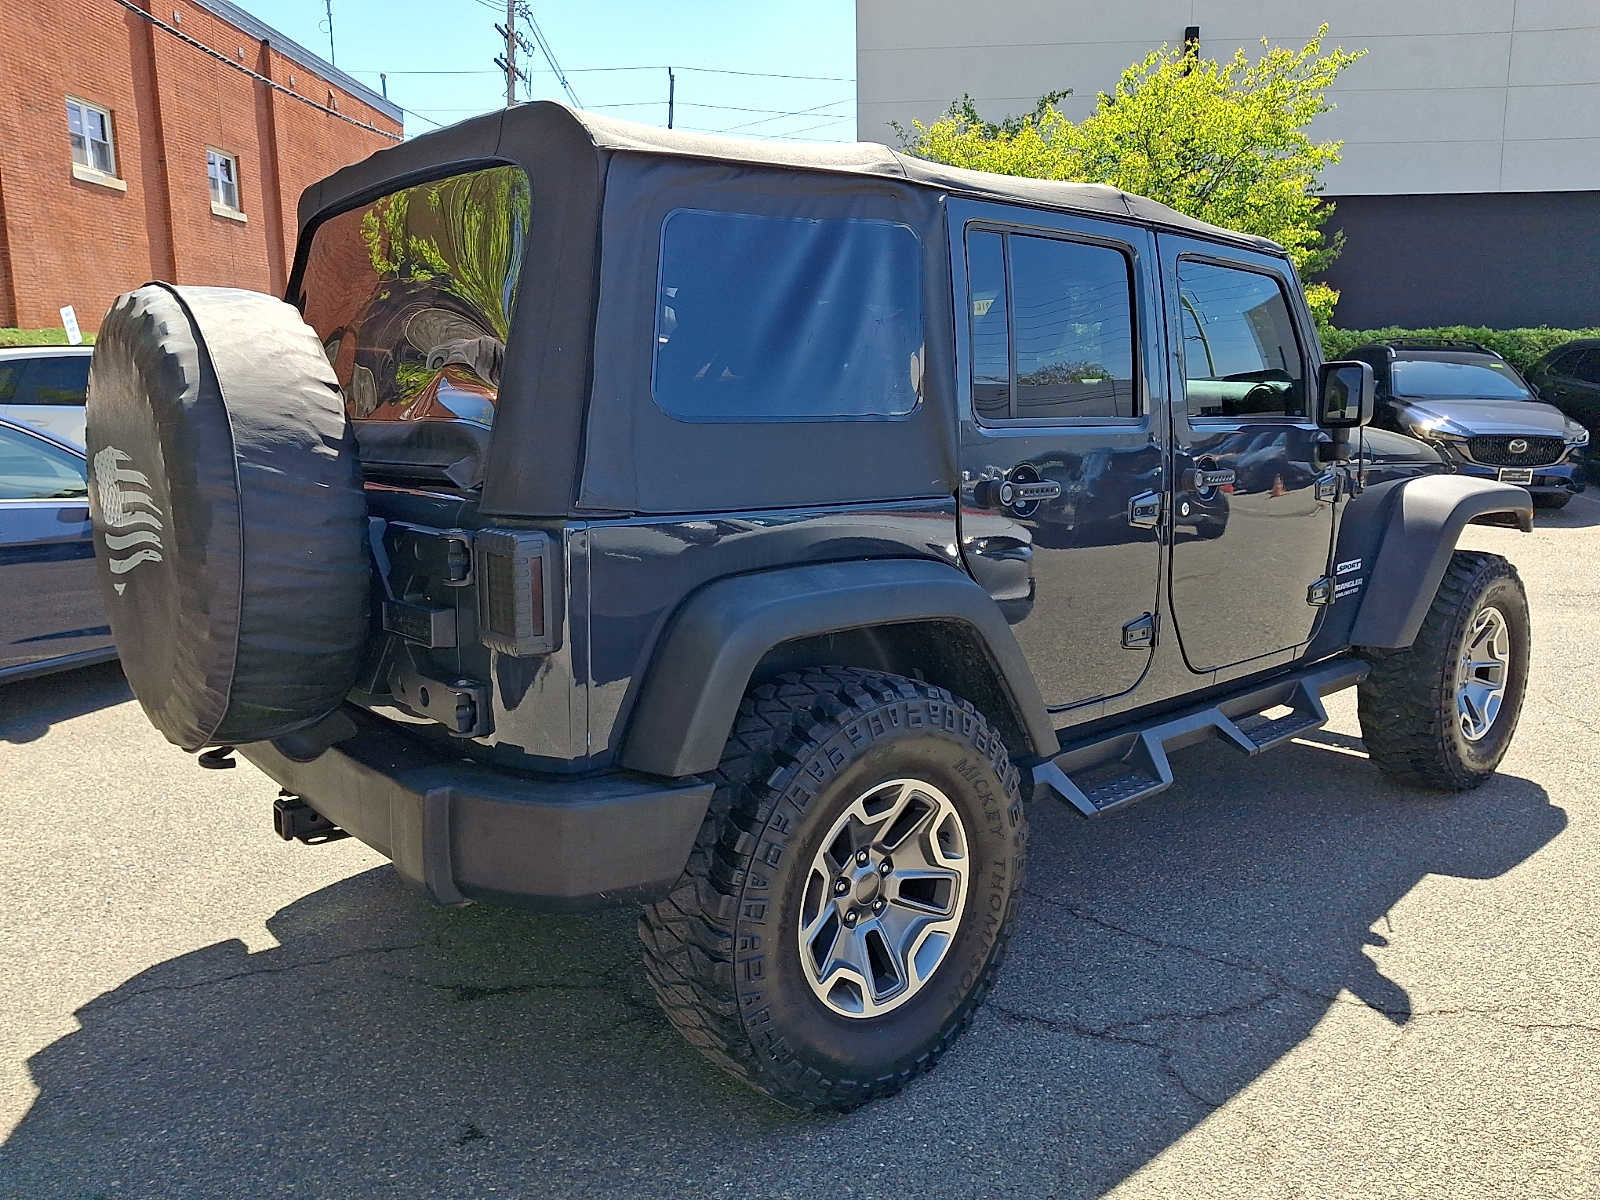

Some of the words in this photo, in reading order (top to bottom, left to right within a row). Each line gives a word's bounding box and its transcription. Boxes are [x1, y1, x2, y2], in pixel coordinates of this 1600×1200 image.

[1338, 560, 1361, 572] SPORT
[953, 758, 1008, 841] MICKEY
[949, 860, 1007, 1002] THOMPSON
